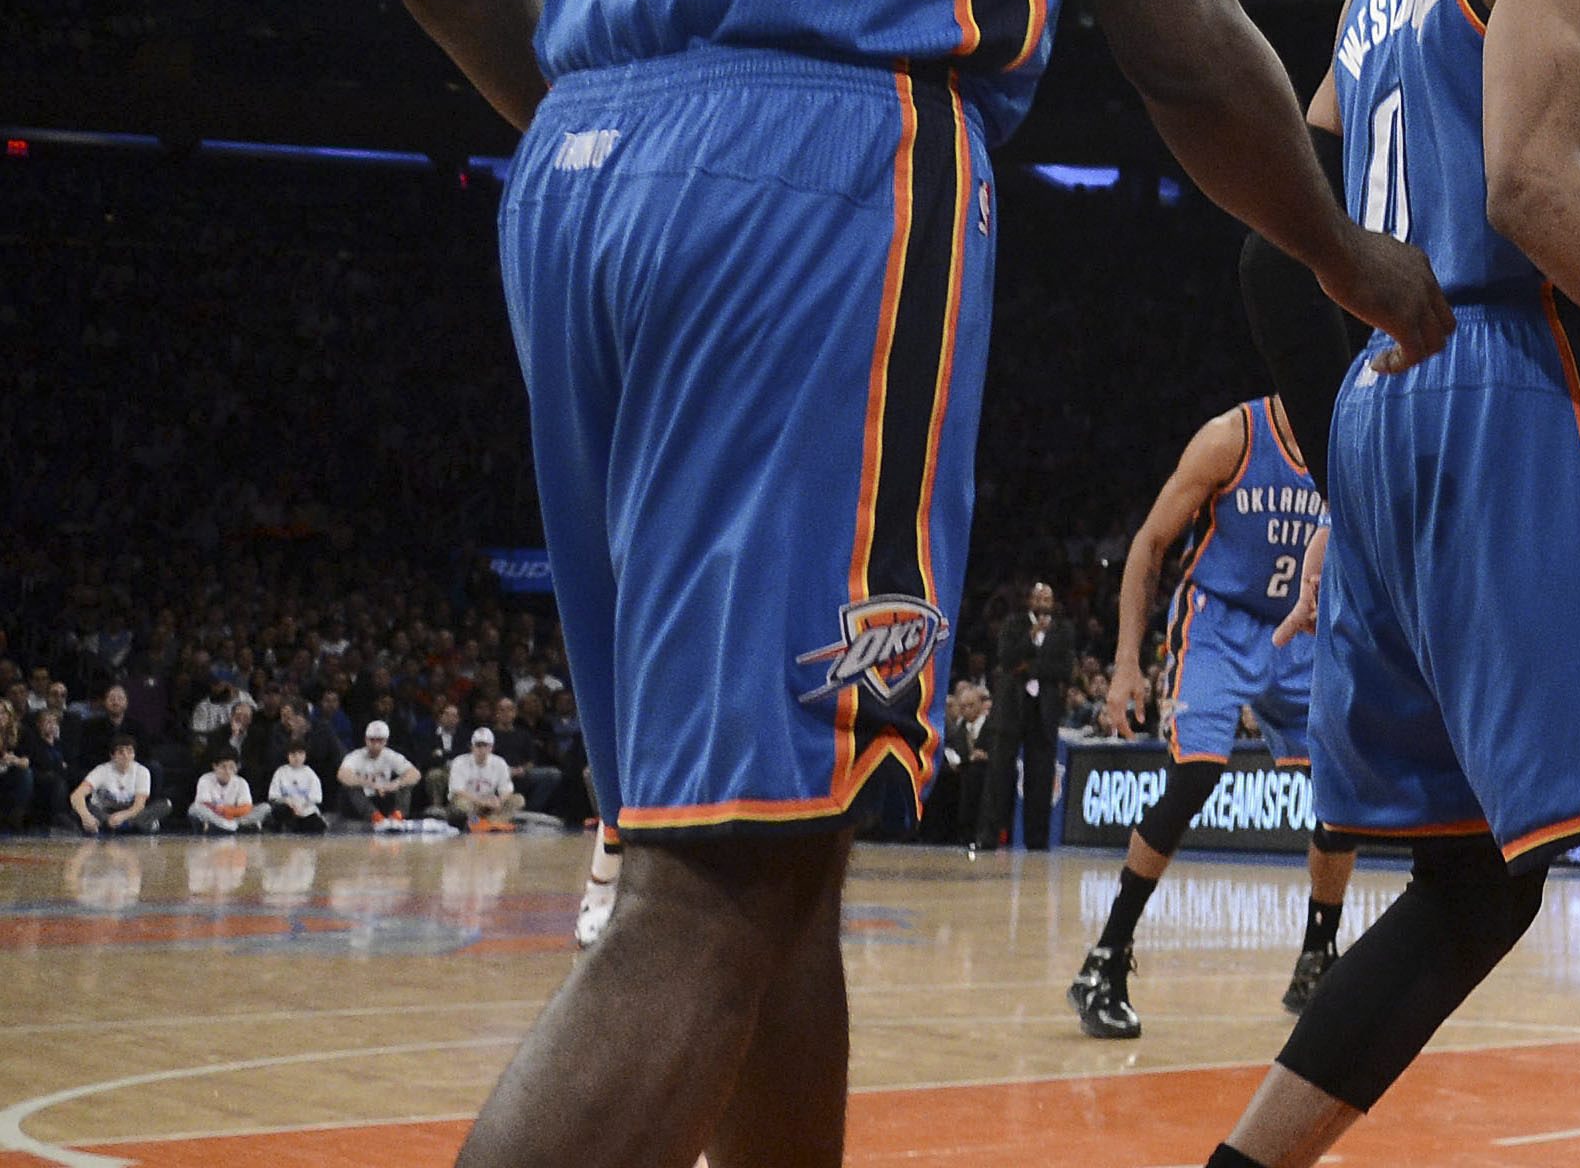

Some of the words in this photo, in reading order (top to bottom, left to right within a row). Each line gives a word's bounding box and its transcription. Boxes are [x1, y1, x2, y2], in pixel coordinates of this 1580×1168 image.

[1235, 485, 1322, 517] OKLAHO
[1267, 518, 1317, 547] CITY
[1266, 555, 1297, 598] 2
